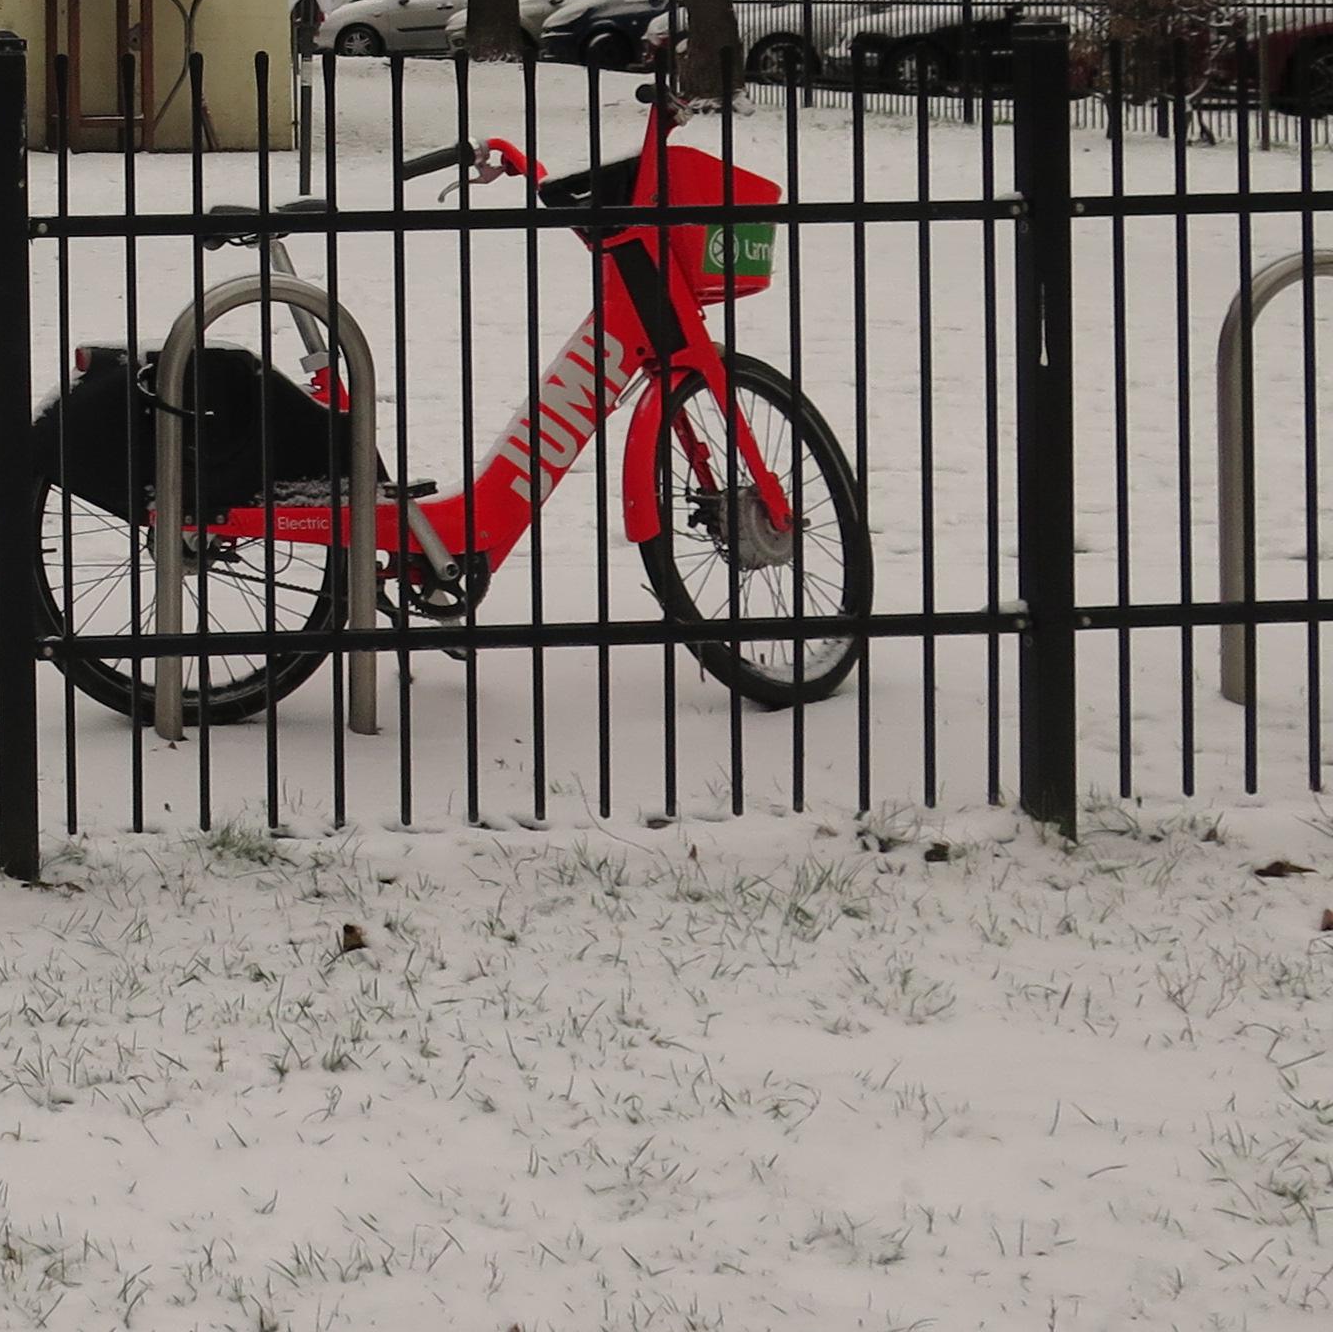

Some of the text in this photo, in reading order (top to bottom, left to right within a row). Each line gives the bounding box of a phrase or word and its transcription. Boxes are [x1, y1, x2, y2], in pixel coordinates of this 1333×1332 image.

[744, 239, 772, 261] Lim
[497, 322, 630, 504] JUMP
[277, 516, 330, 530] Electric
